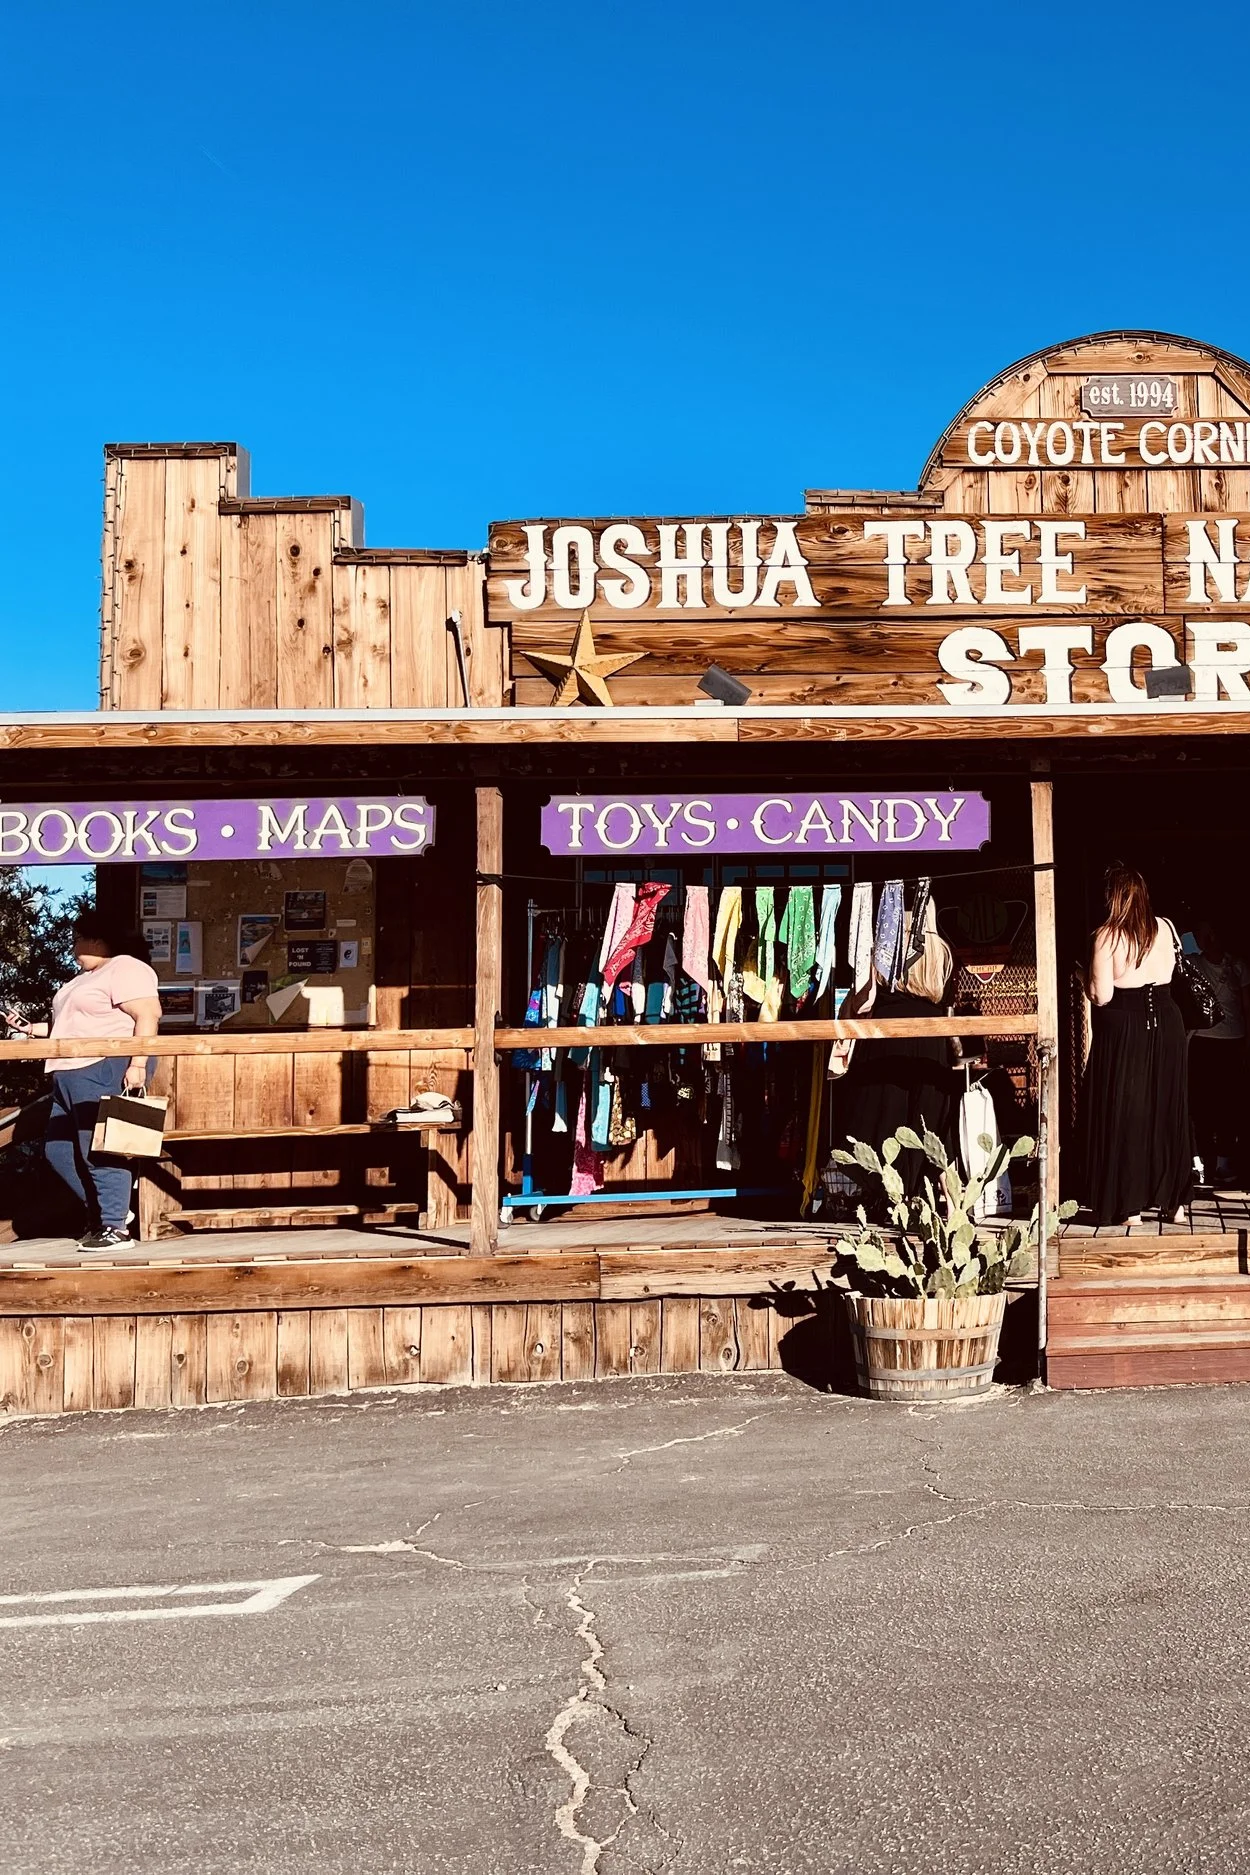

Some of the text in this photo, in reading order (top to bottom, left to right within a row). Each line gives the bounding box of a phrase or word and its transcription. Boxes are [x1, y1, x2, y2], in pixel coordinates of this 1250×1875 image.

[1088, 382, 1174, 408] est. 1994
[967, 421, 1125, 466] COYOTE
[502, 521, 821, 610] JOSHUA
[863, 519, 1087, 606] TREE
[0, 803, 428, 859] BOOKS MAPS
[558, 797, 966, 849] TOYS CANDY
